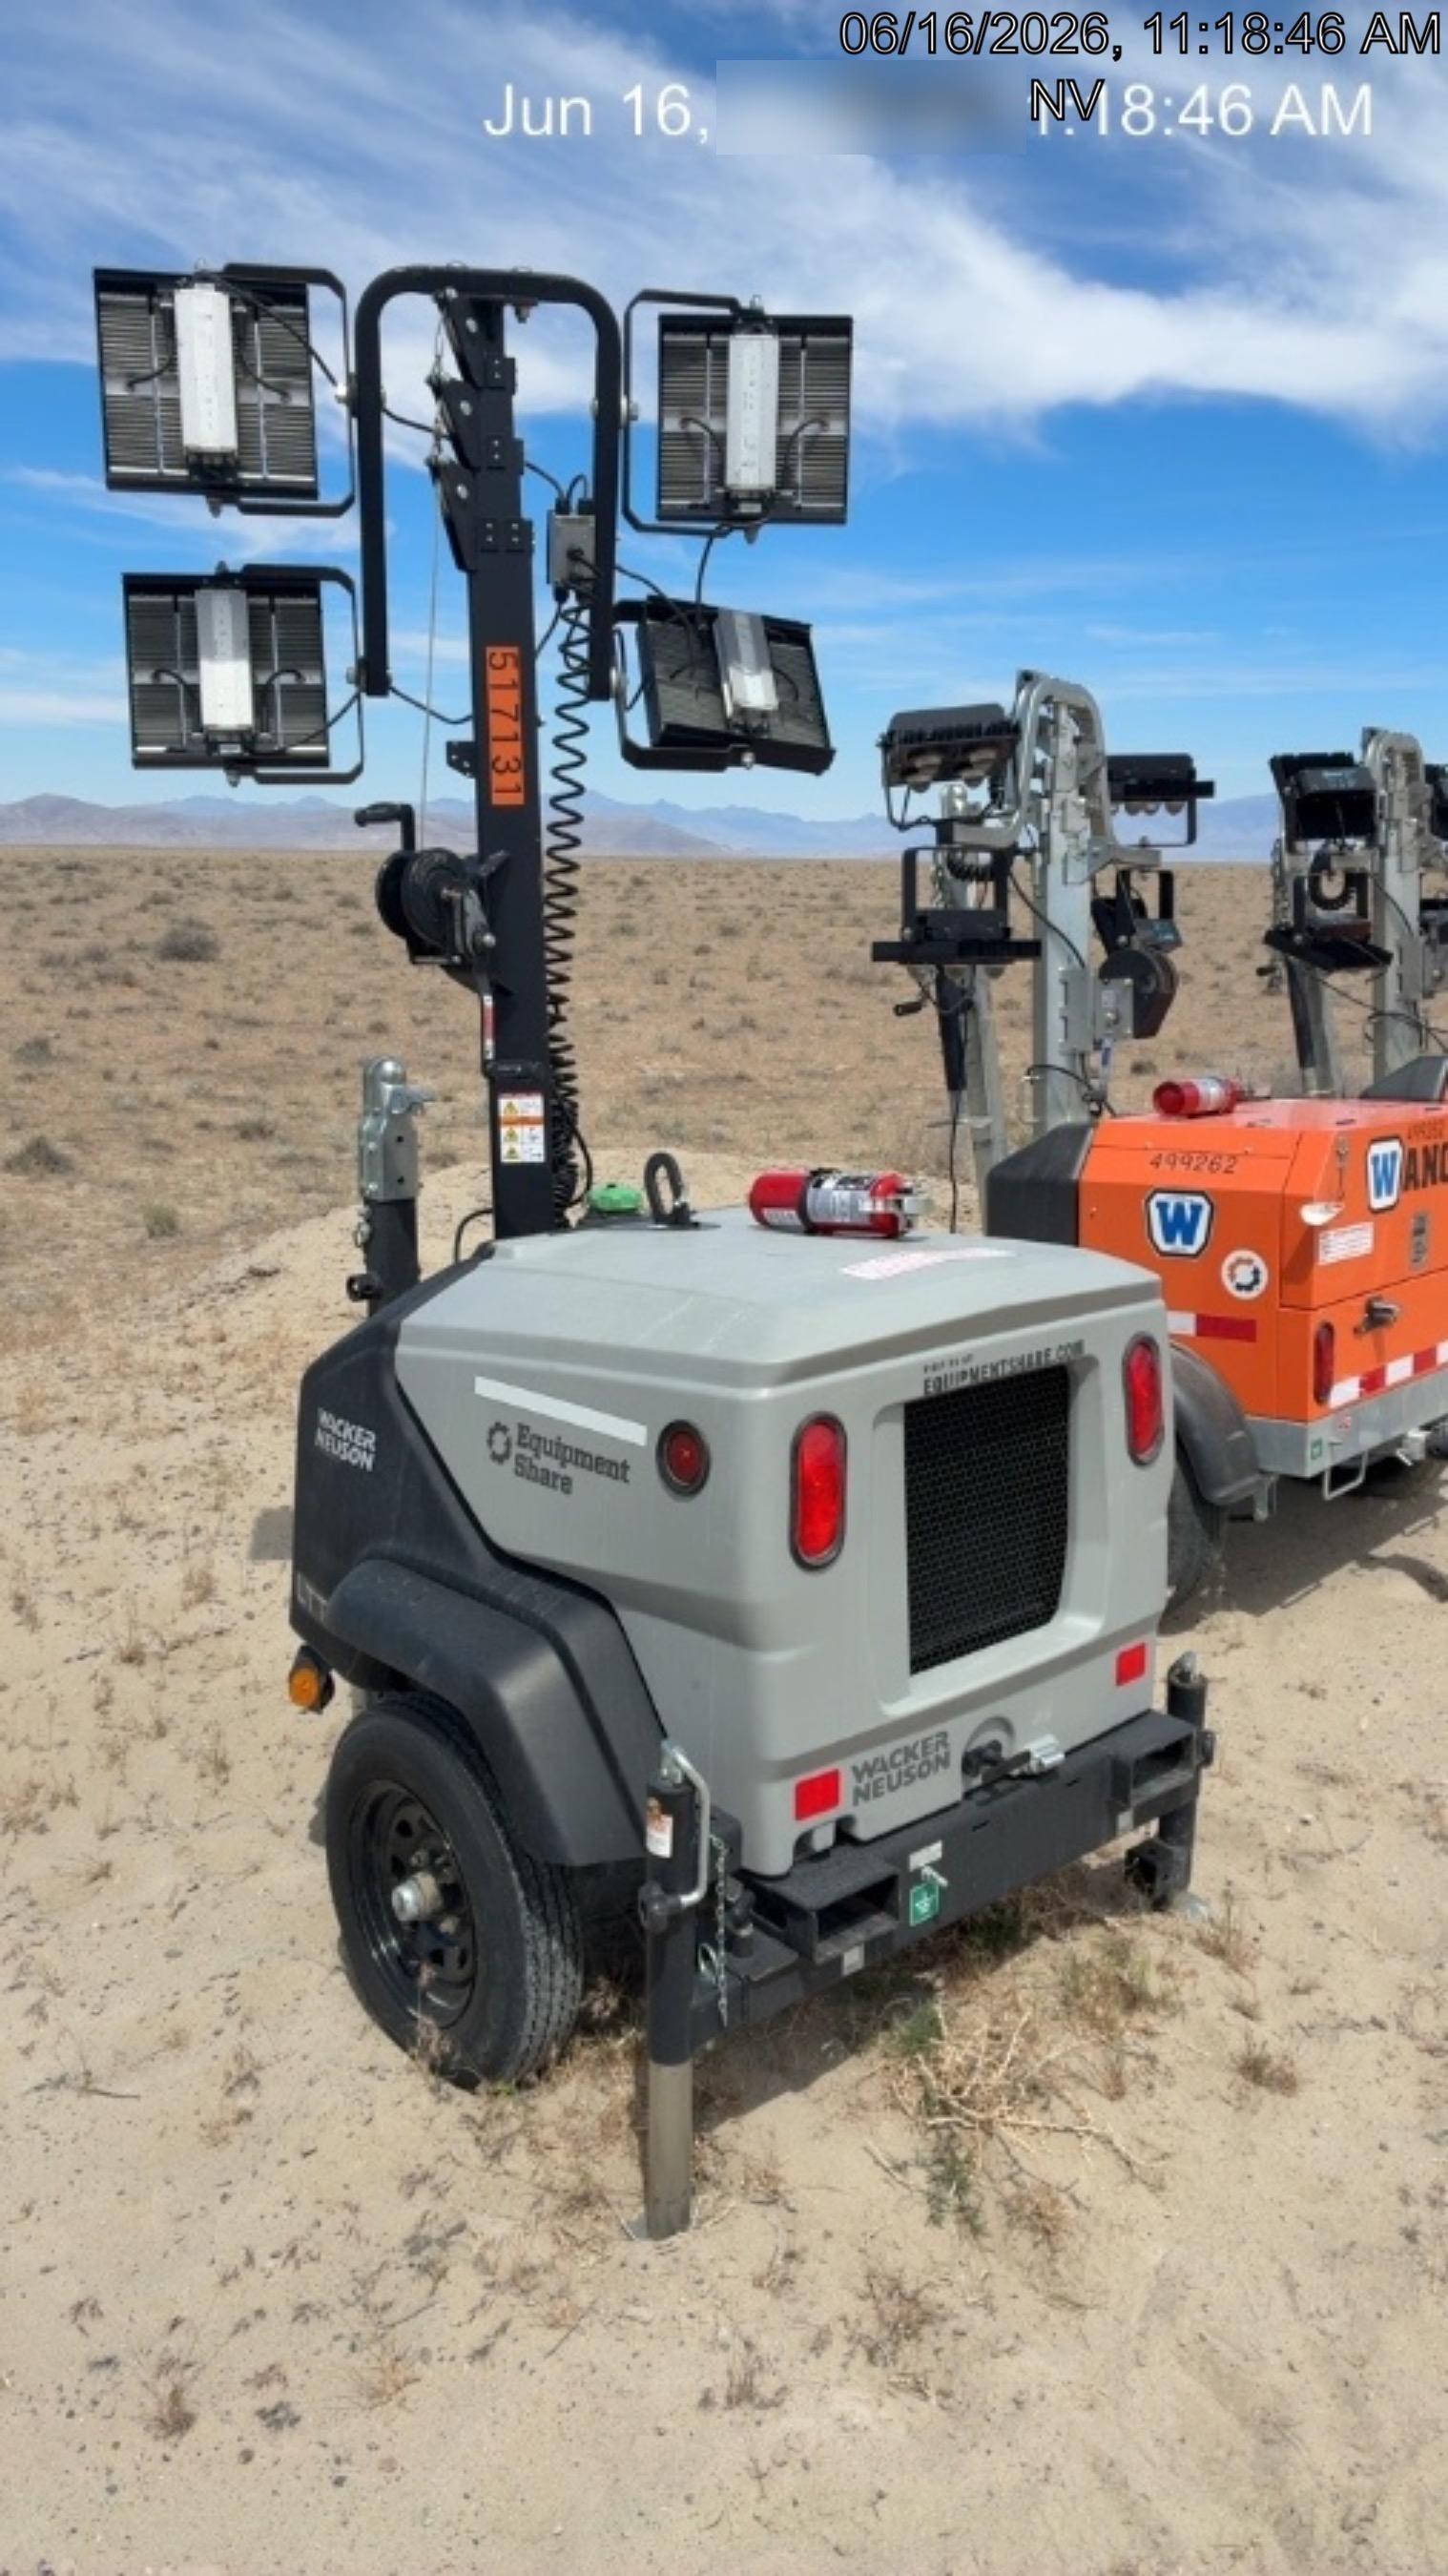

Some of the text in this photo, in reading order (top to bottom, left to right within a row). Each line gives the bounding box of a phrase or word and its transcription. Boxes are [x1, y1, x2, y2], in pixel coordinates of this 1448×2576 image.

[488, 652, 522, 794] 517131
[1154, 1200, 1204, 1246] W
[315, 1426, 375, 1472] NEUSON
[317, 1406, 376, 1452] WACKER
[516, 1423, 631, 1484] Equipment
[514, 1453, 573, 1495] Share
[851, 1731, 949, 1783] WACKER
[852, 1751, 951, 1807] NEUSON
